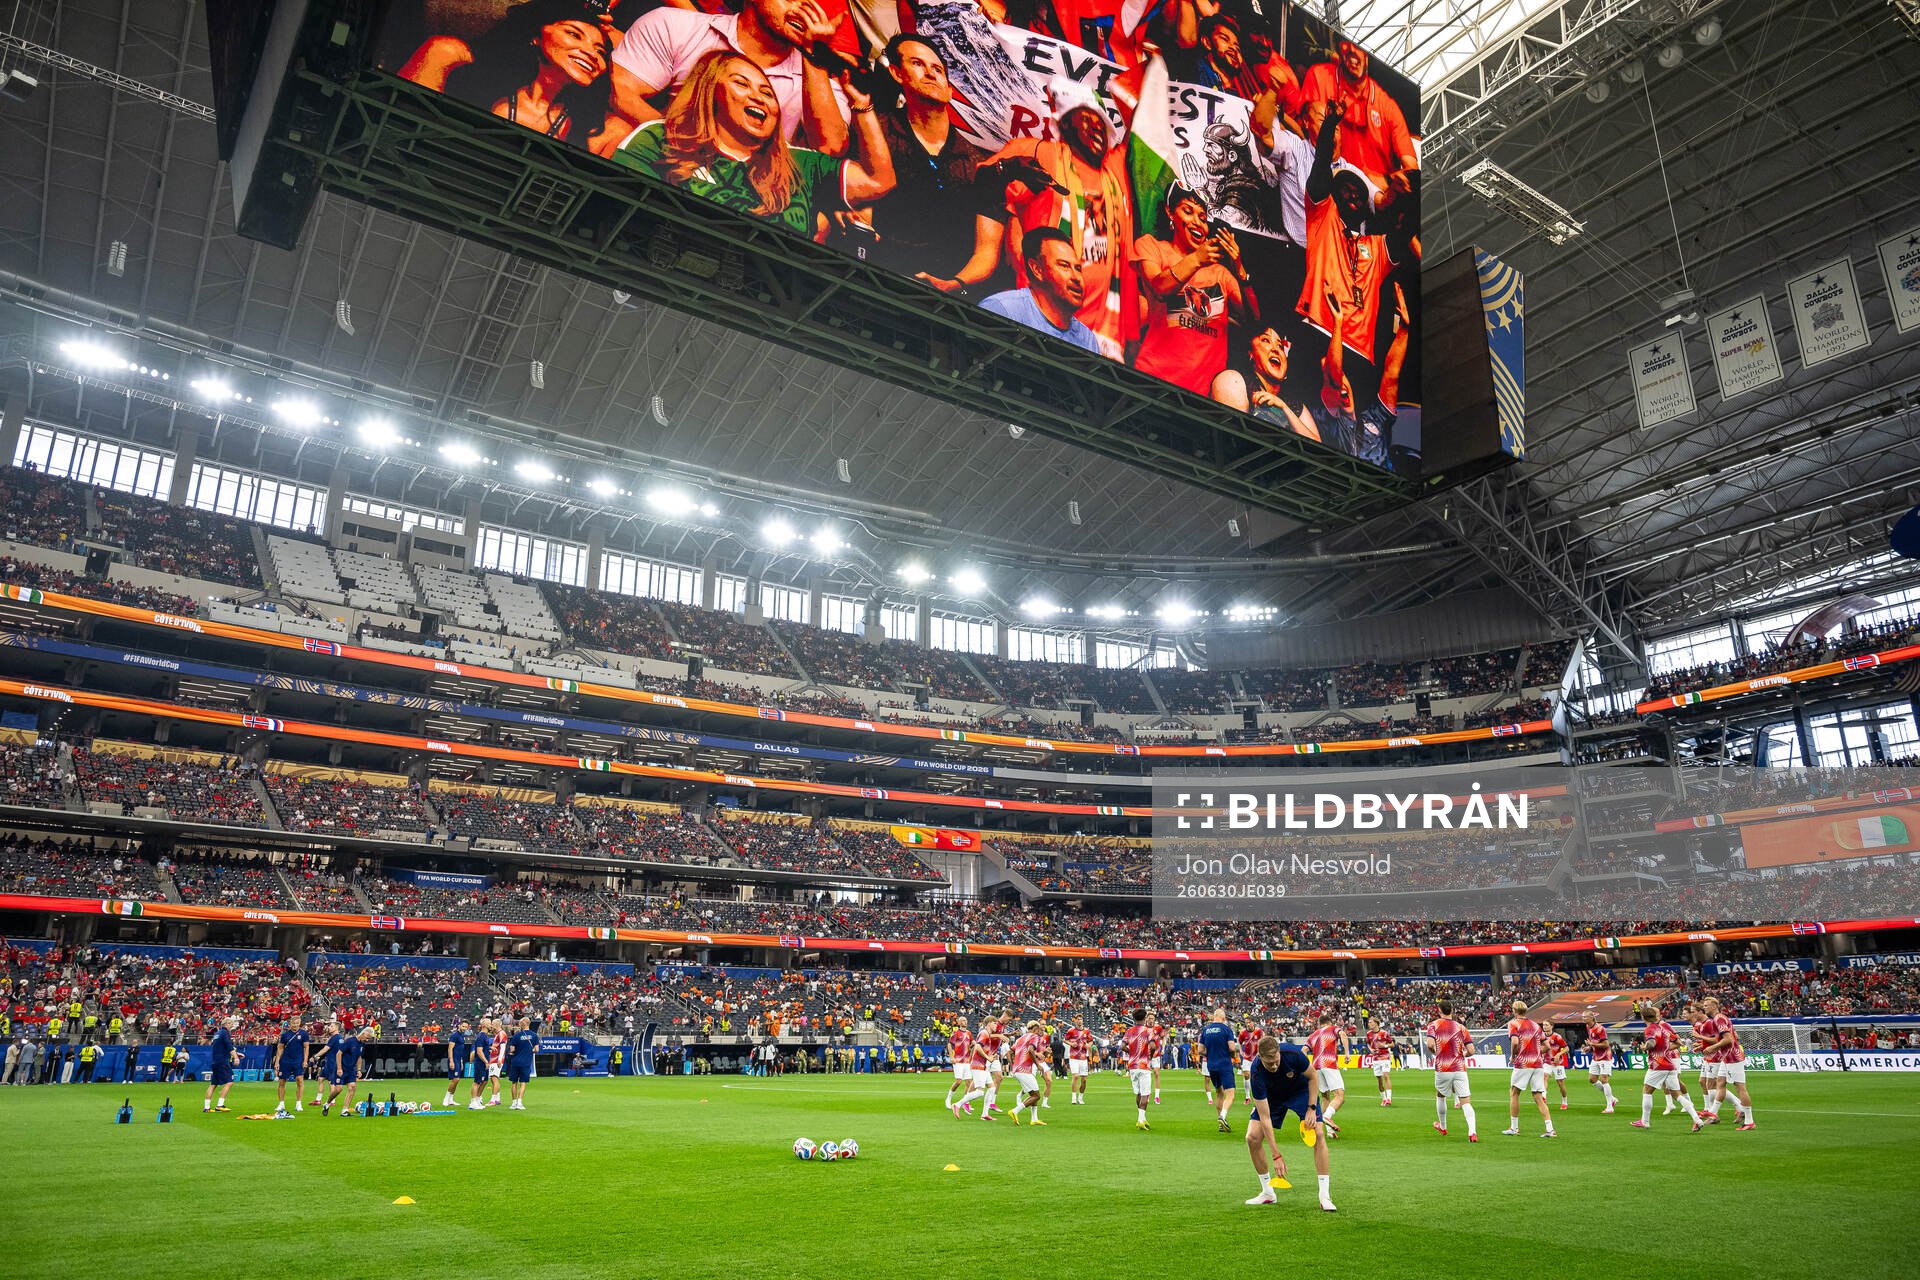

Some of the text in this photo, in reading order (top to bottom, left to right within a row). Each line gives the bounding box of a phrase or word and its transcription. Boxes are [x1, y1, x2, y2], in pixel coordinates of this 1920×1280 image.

[1804, 288, 1844, 308] COWBOYS
[1806, 283, 1838, 300] DALLAS
[1722, 324, 1758, 343] COWBOYS
[1723, 319, 1752, 335] DALLAS
[1814, 326, 1849, 342] WORLD
[1806, 329, 1861, 354] CHAMPIONS
[1826, 343, 1846, 355] 1992
[1644, 353, 1671, 367] DALLAS
[1720, 345, 1742, 359] SUPER
[1642, 358, 1676, 375] COWBOYS
[1732, 359, 1764, 376] WORLD
[1724, 363, 1775, 387] CHAMPIONS
[1742, 377, 1760, 388] 1977
[154, 614, 205, 633] CÔTE D'IVOIR
[123, 653, 180, 670] #FIFAWorldCup
[24, 685, 74, 703] CÔTE D'IVOIR
[754, 743, 800, 754] DALLAS
[914, 760, 929, 768] FIFA
[929, 762, 953, 770] WORLD
[1717, 960, 1800, 975] DALLAS
[1849, 957, 1876, 968] FIFA
[1780, 1058, 1820, 1068] BANK
[1850, 1058, 1920, 1067] AMERICA
